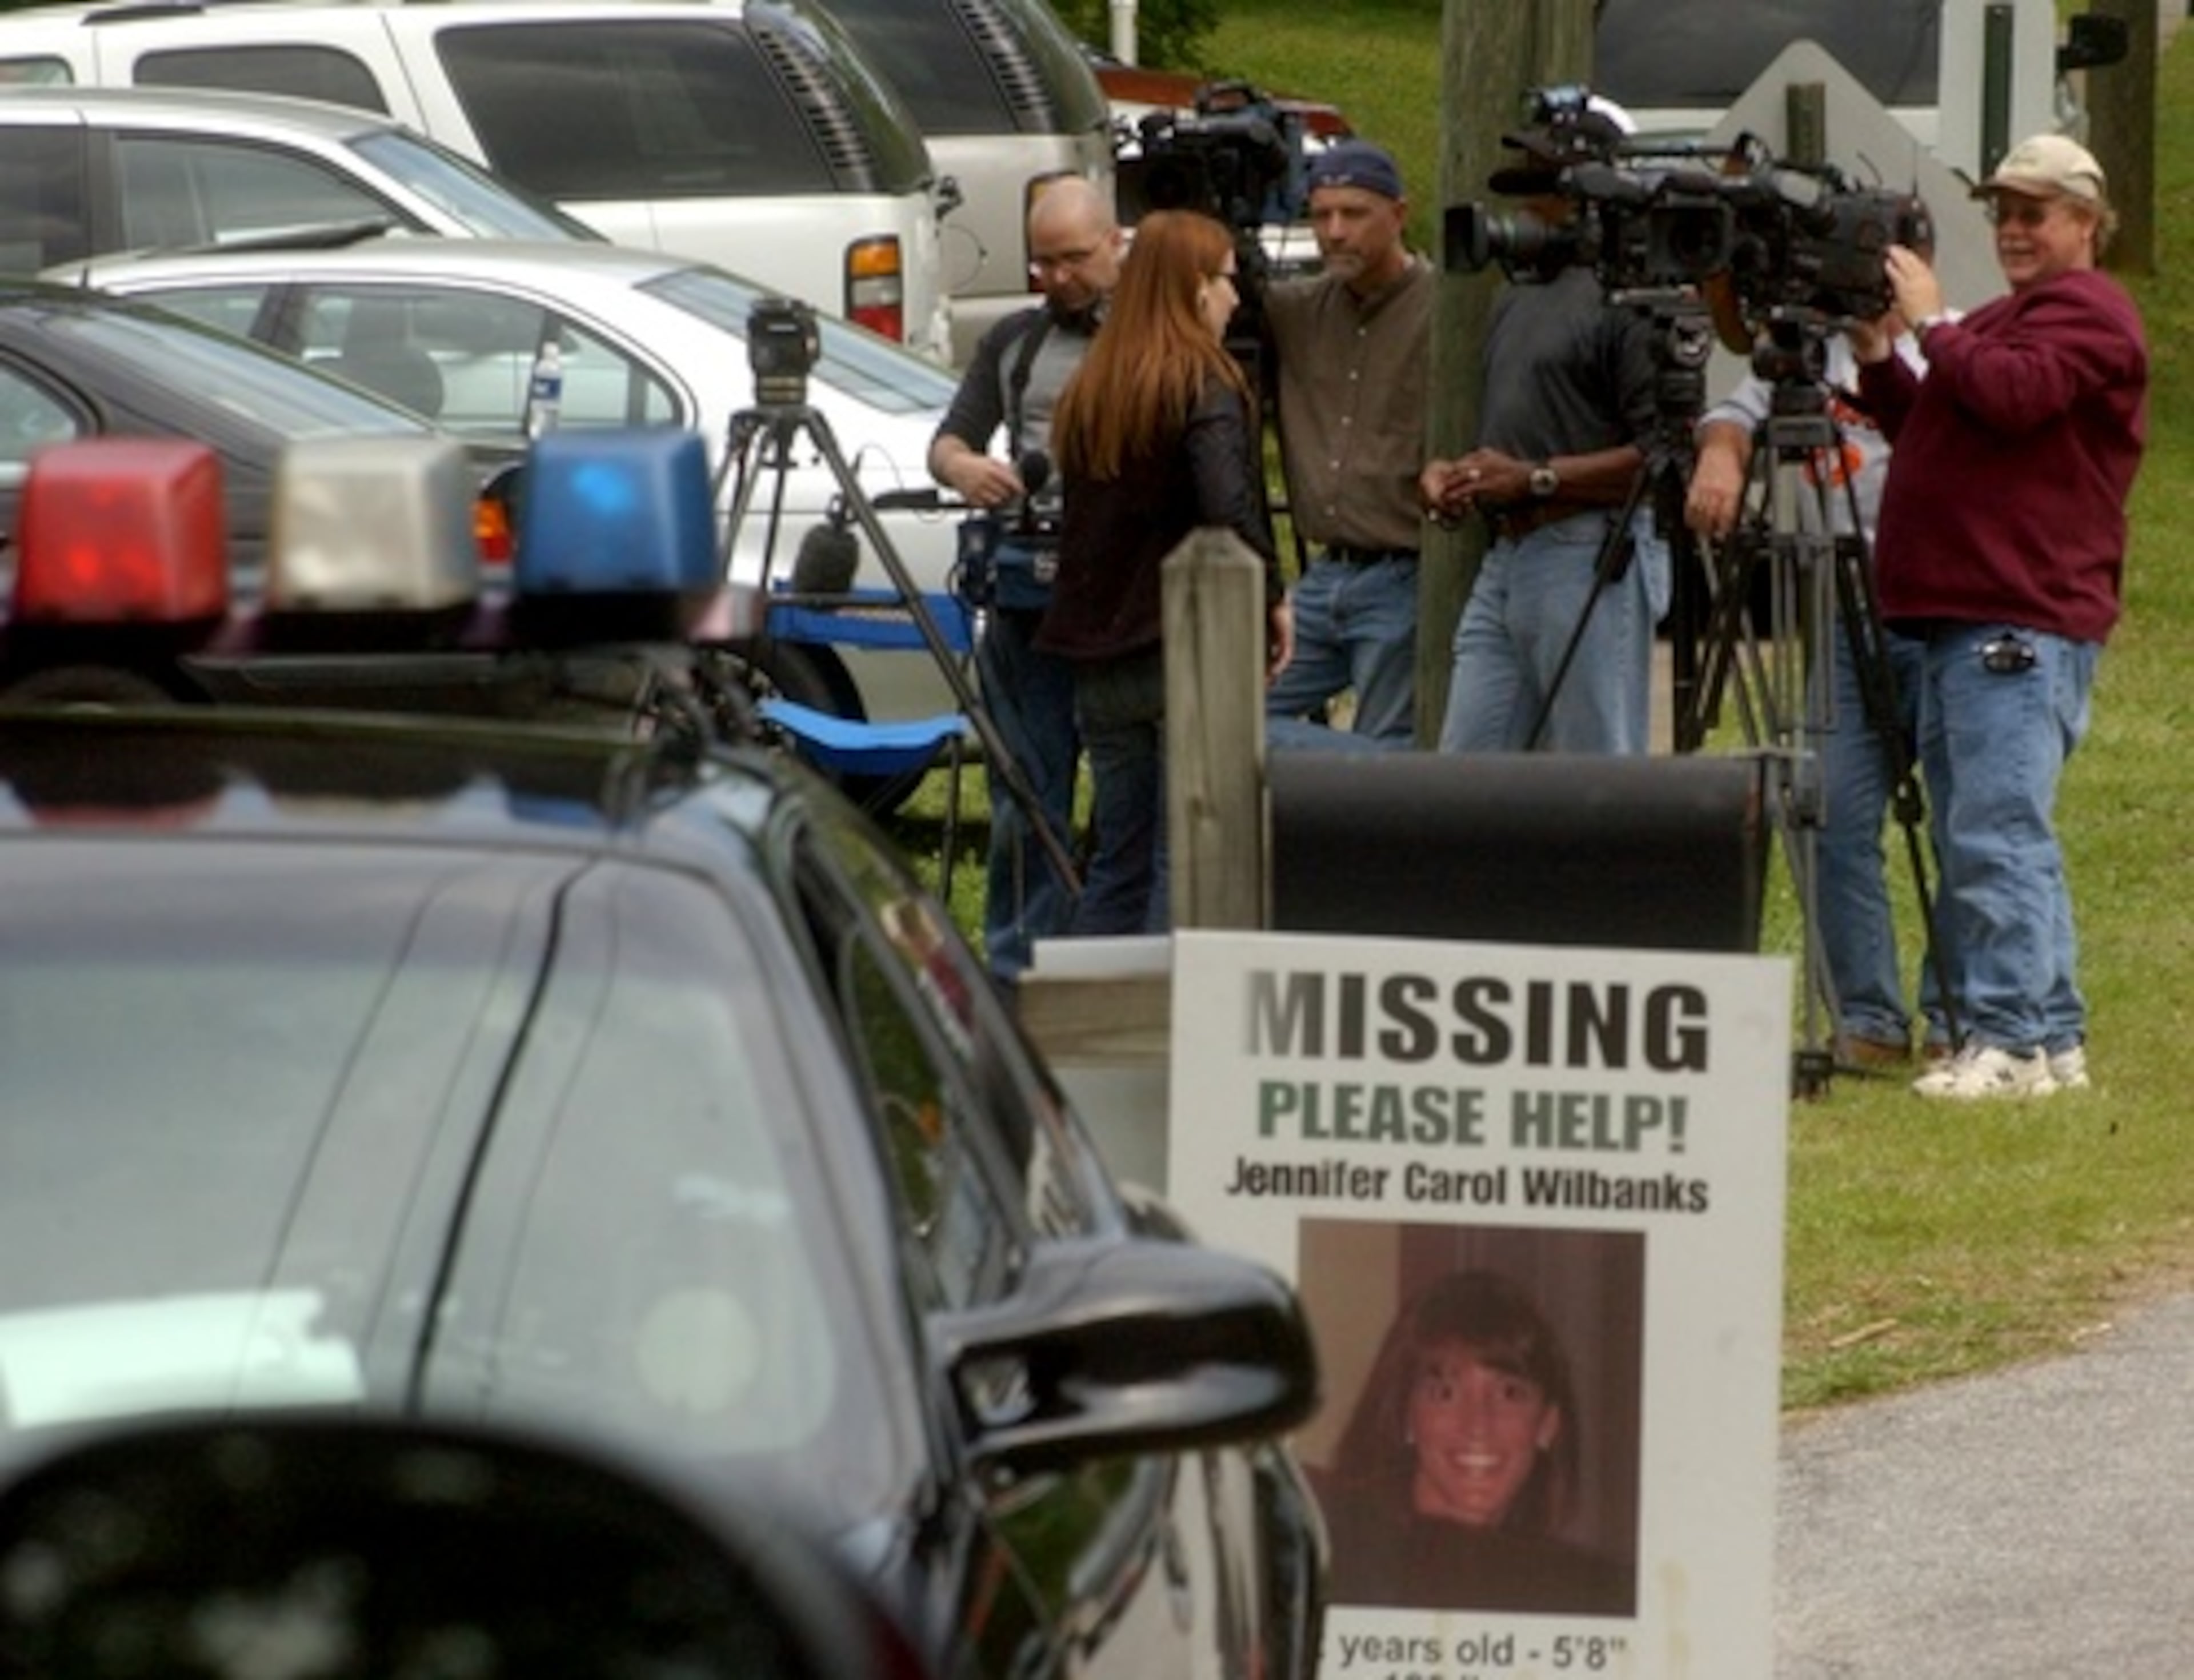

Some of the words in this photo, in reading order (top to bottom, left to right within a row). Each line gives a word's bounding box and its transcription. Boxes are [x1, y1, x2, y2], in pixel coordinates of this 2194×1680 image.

[1247, 969, 1708, 1073] MISSING
[1258, 1081, 1484, 1147] PLEASE
[1510, 1090, 1688, 1153] HELP!
[1225, 1156, 1391, 1201] Jennifer
[1404, 1162, 1507, 1206] Carol
[1523, 1168, 1708, 1213] Wilbanks
[1338, 1634, 1443, 1669] years
[1455, 1633, 1515, 1666] old
